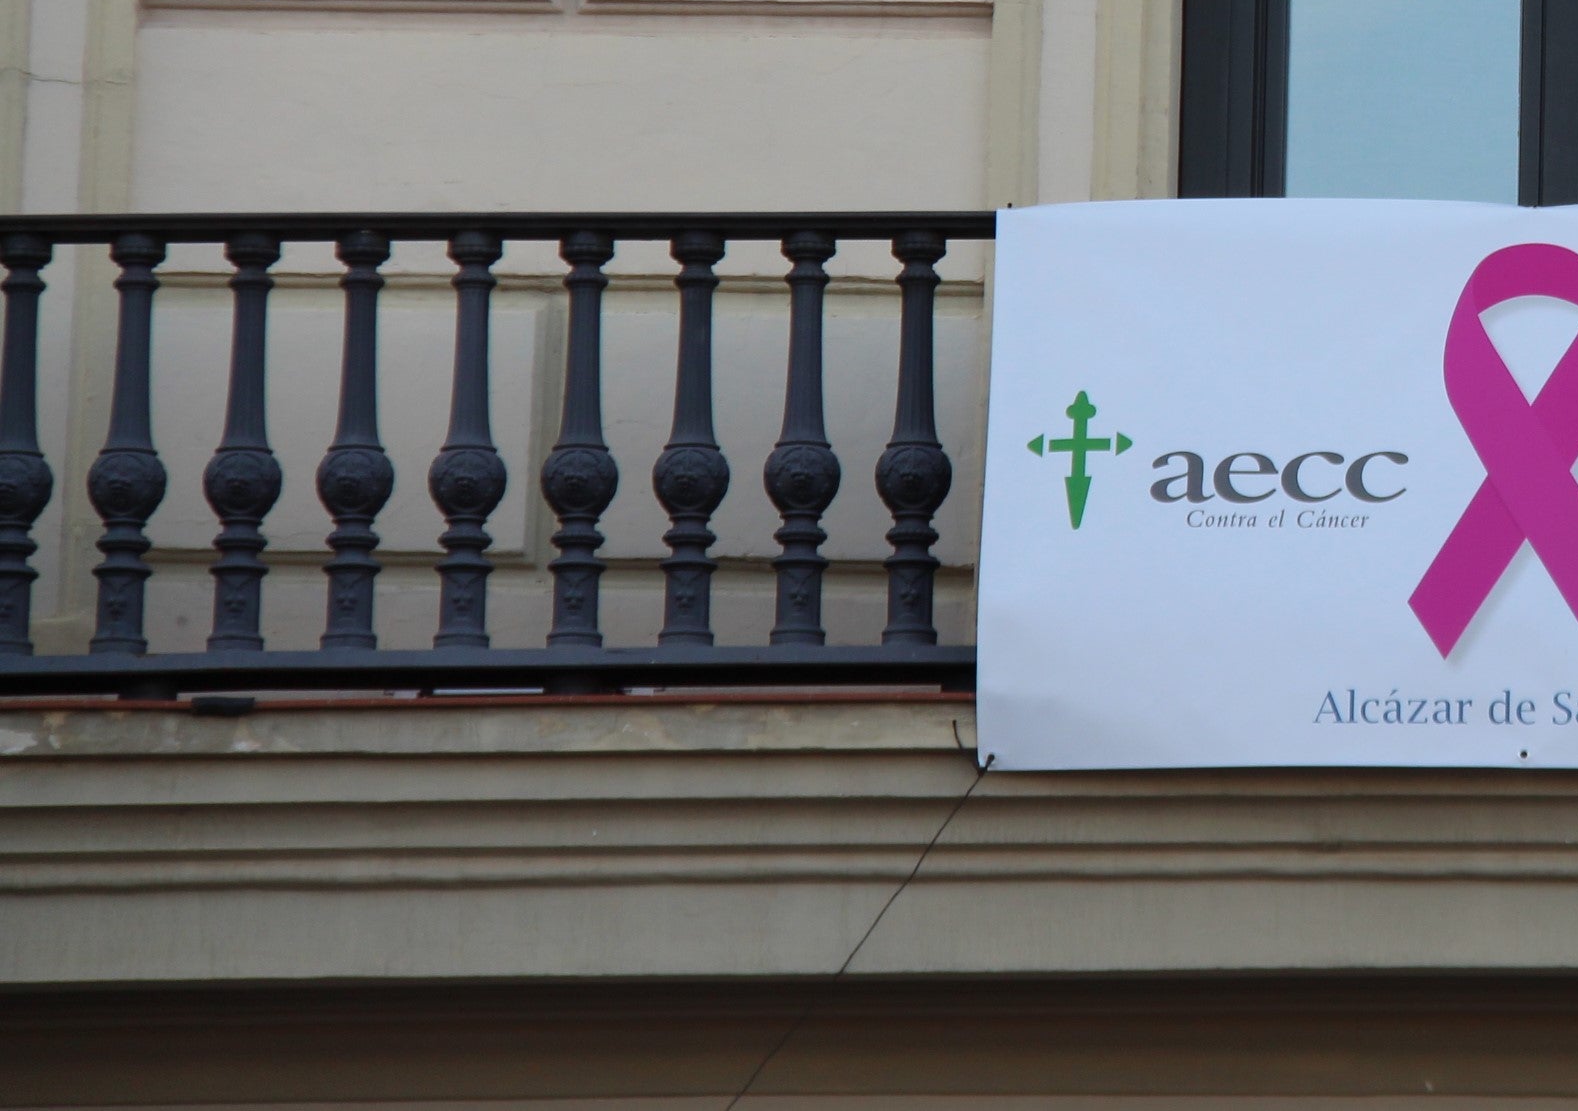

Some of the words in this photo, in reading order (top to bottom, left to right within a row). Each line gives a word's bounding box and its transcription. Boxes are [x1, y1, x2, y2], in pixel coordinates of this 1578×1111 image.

[1150, 451, 1409, 503] aecc
[1187, 509, 1257, 528] Contra
[1268, 509, 1285, 528] el
[1297, 509, 1370, 528] Cáncer
[1313, 689, 1473, 725] Alcázar
[1488, 690, 1536, 726] de
